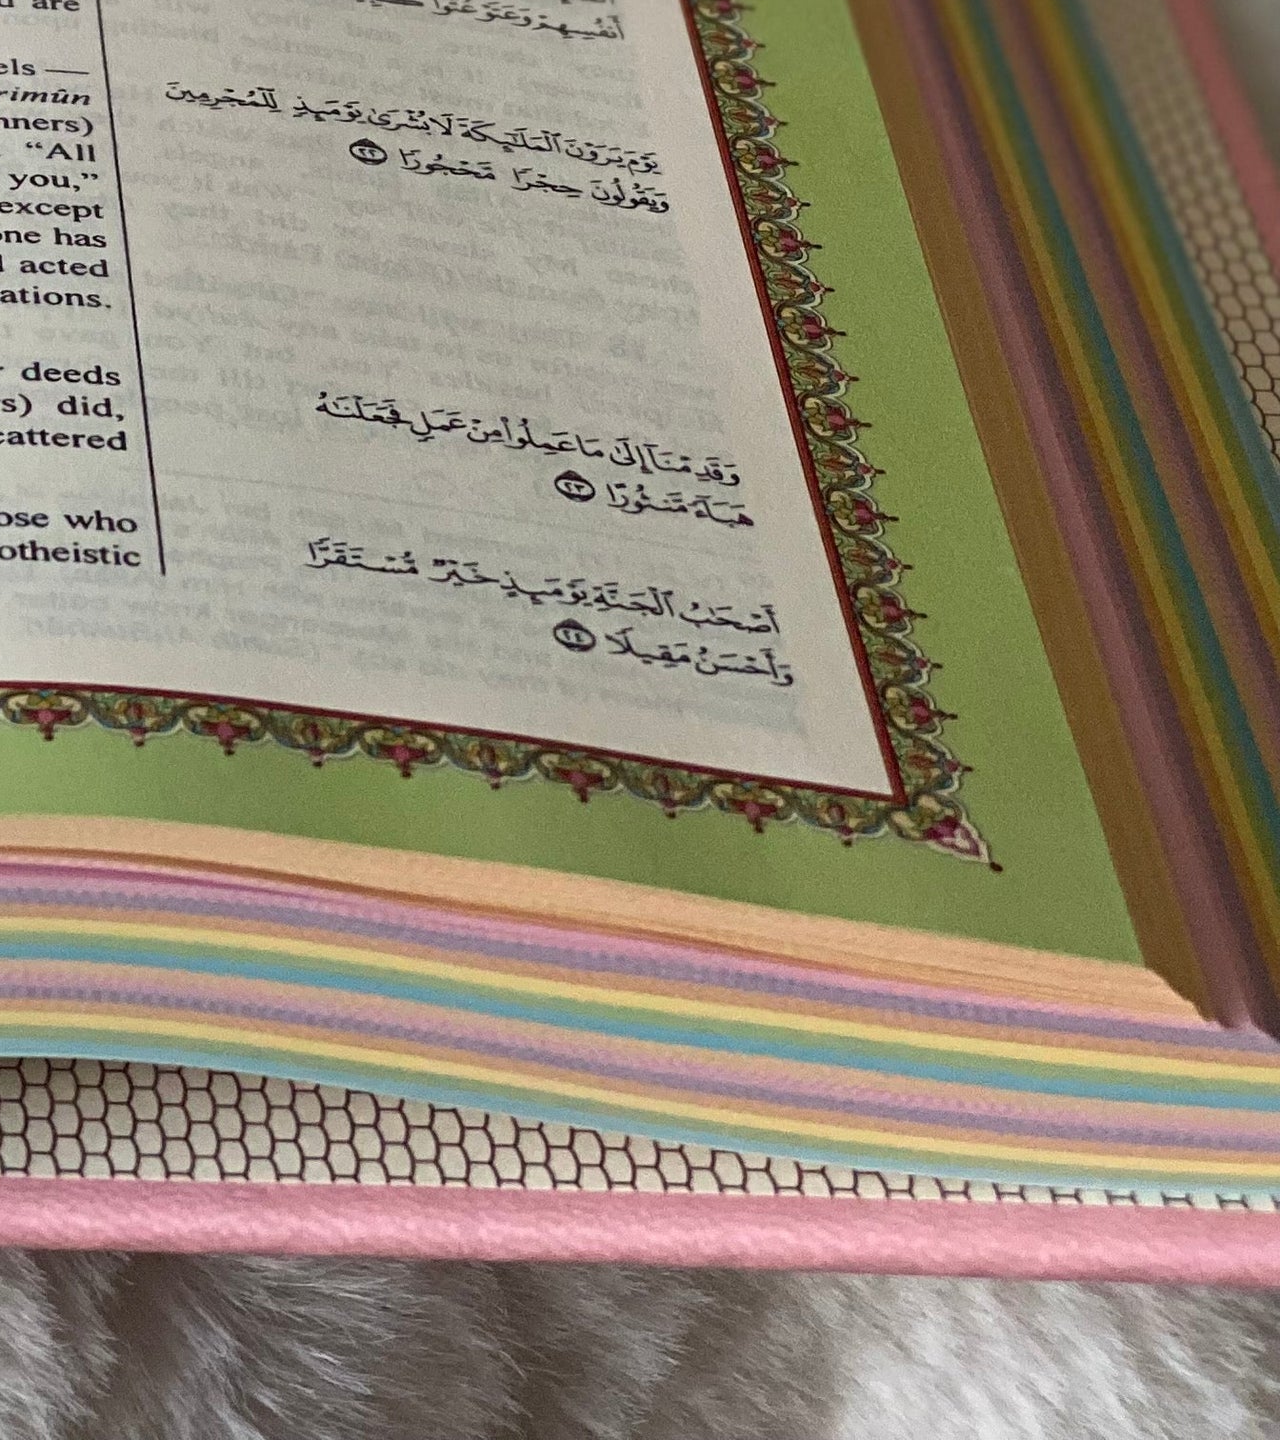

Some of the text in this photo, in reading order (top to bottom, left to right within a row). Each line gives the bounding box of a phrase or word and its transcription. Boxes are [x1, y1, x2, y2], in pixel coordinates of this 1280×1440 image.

[20, 360, 122, 387] deeds
[56, 394, 126, 423] did,
[62, 509, 139, 534] who
